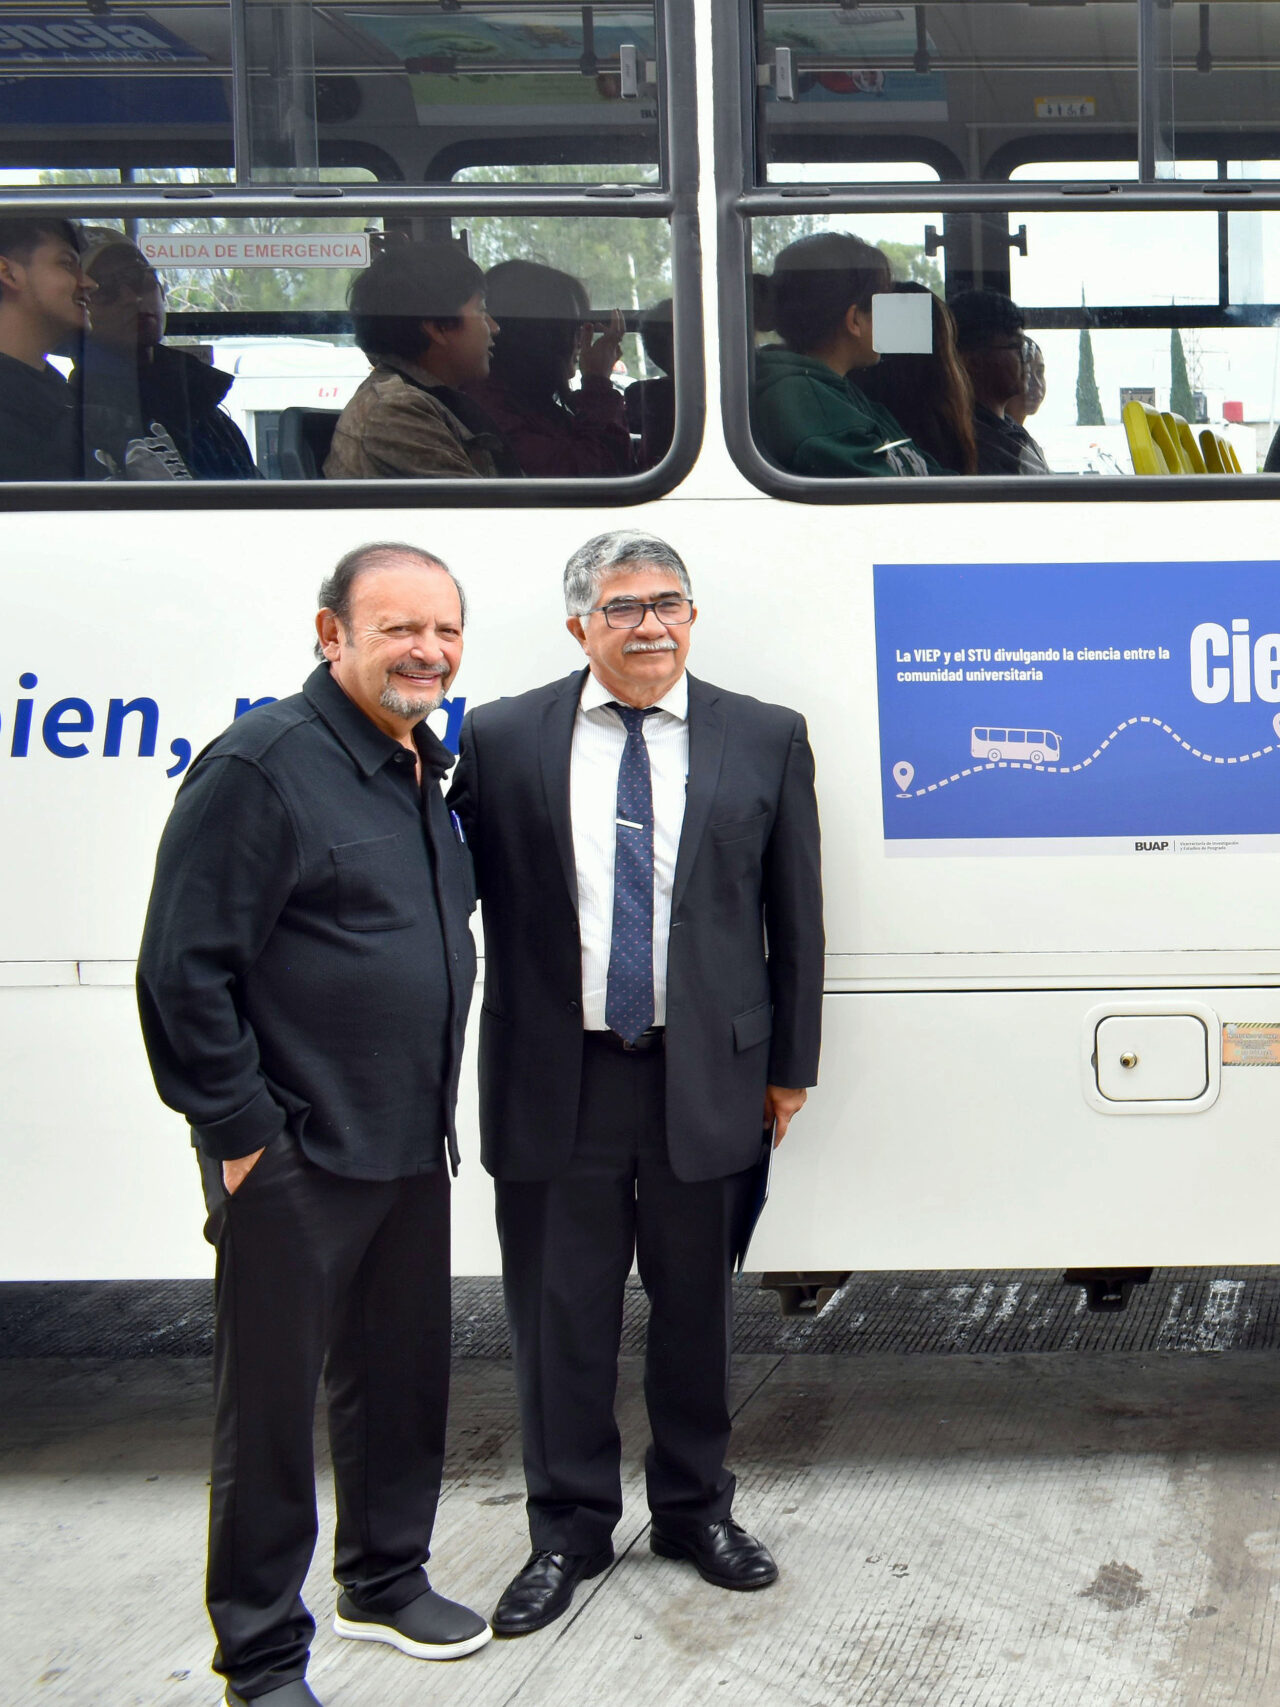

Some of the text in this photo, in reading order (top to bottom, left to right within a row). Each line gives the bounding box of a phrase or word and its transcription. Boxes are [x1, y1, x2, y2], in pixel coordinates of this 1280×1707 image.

[145, 243, 362, 258] SALIDA DE EMERGENCIA
[895, 646, 1171, 666] La VIEP y el STU divulgando la ciencia entre la
[896, 667, 1044, 682] comunidad universitaria
[0, 672, 192, 778] ien,
[1134, 841, 1169, 851] BUAP
